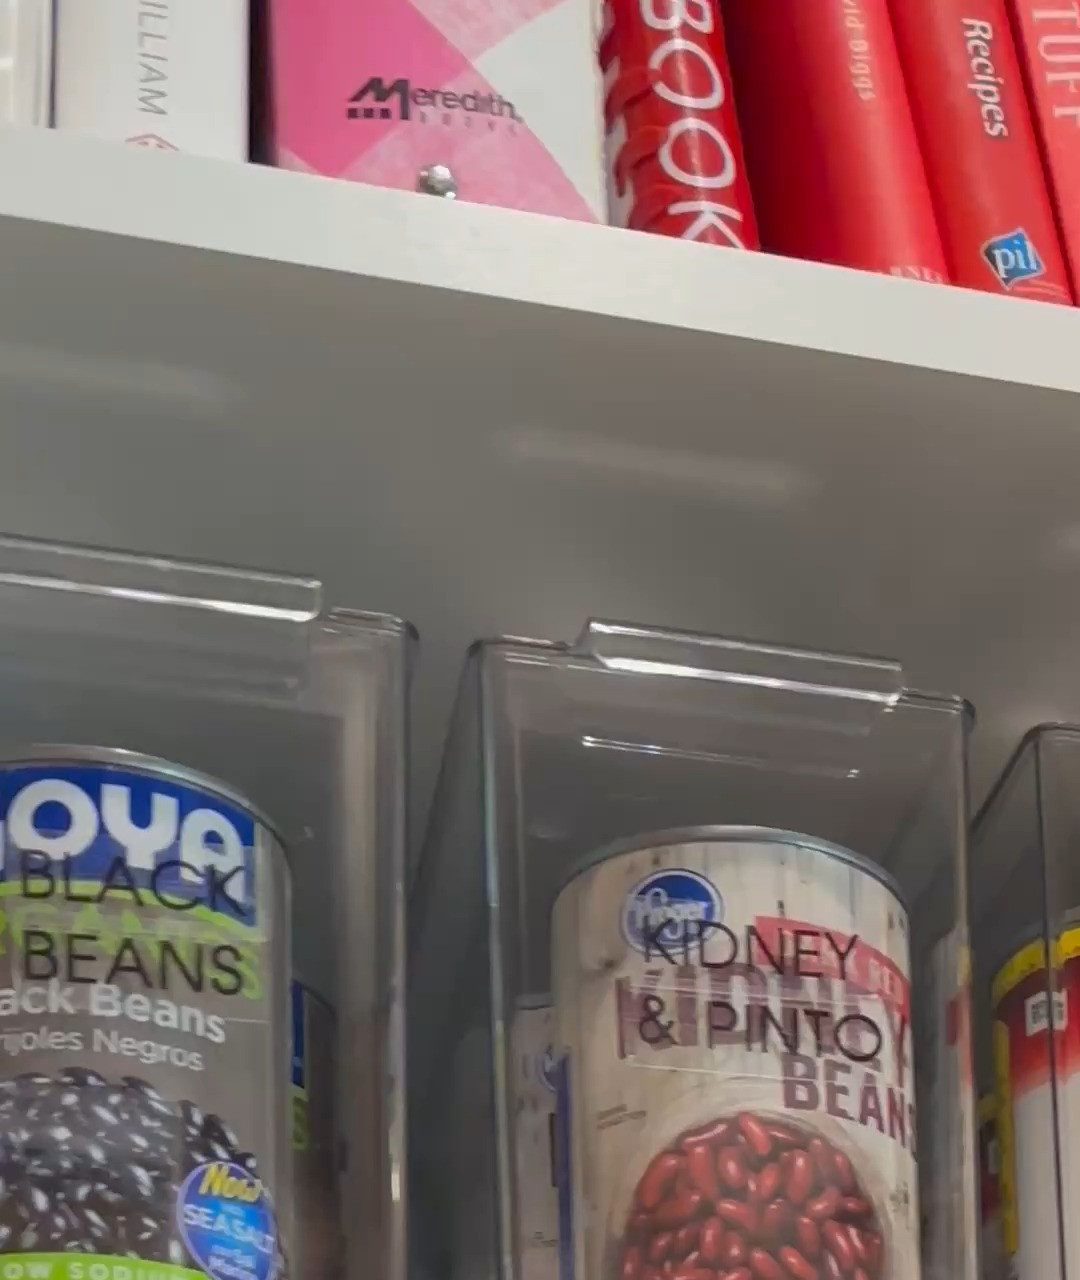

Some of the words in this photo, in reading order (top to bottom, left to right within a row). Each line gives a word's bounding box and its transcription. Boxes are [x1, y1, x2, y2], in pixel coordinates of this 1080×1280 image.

[961, 18, 1009, 138] Recipes
[20, 850, 248, 917] BLACK
[24, 930, 243, 995] BEANS
[640, 914, 860, 979] KIDNEY
[88, 982, 227, 1044] Beans
[638, 993, 679, 1046] &
[705, 1000, 882, 1062] PINTO
[92, 1027, 206, 1071] Negros
[782, 1053, 916, 1150] BEAN
[3, 1261, 53, 1280] OW
